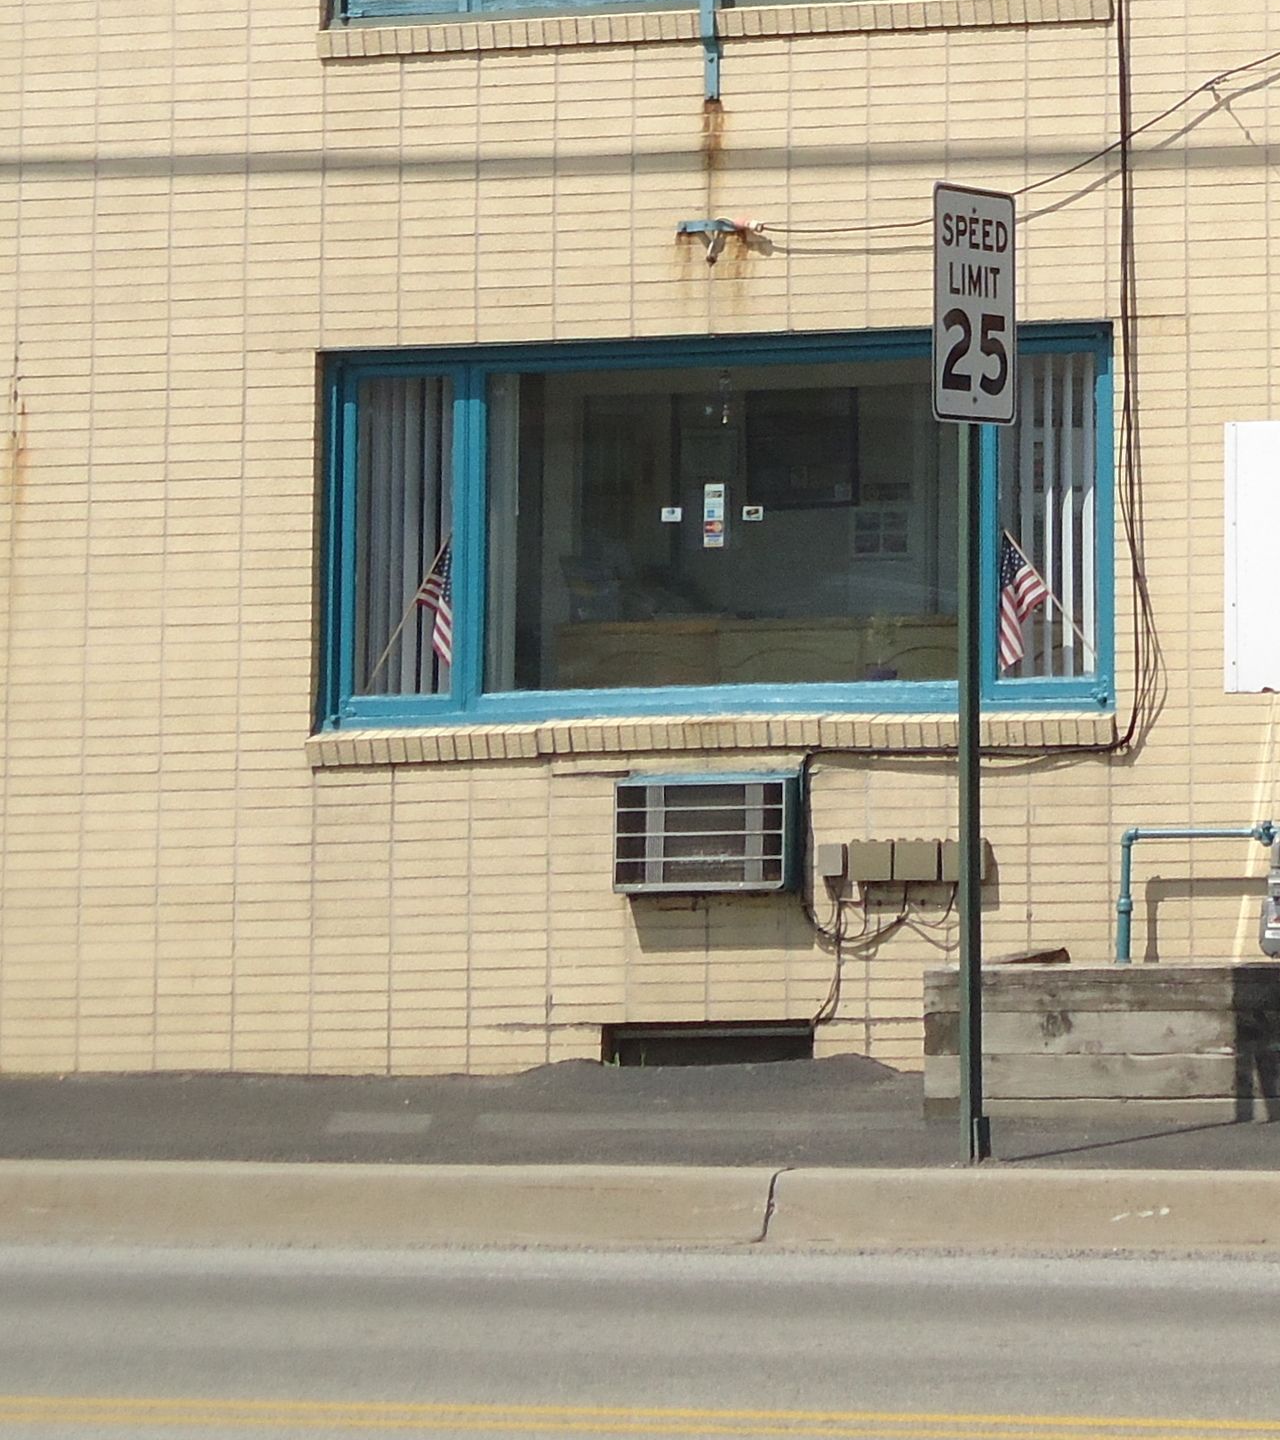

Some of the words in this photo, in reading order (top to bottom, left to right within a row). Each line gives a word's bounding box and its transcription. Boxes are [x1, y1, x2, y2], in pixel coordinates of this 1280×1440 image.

[942, 212, 1008, 253] SPEED
[949, 261, 1000, 299] LIMIT
[942, 308, 1008, 396] 25
